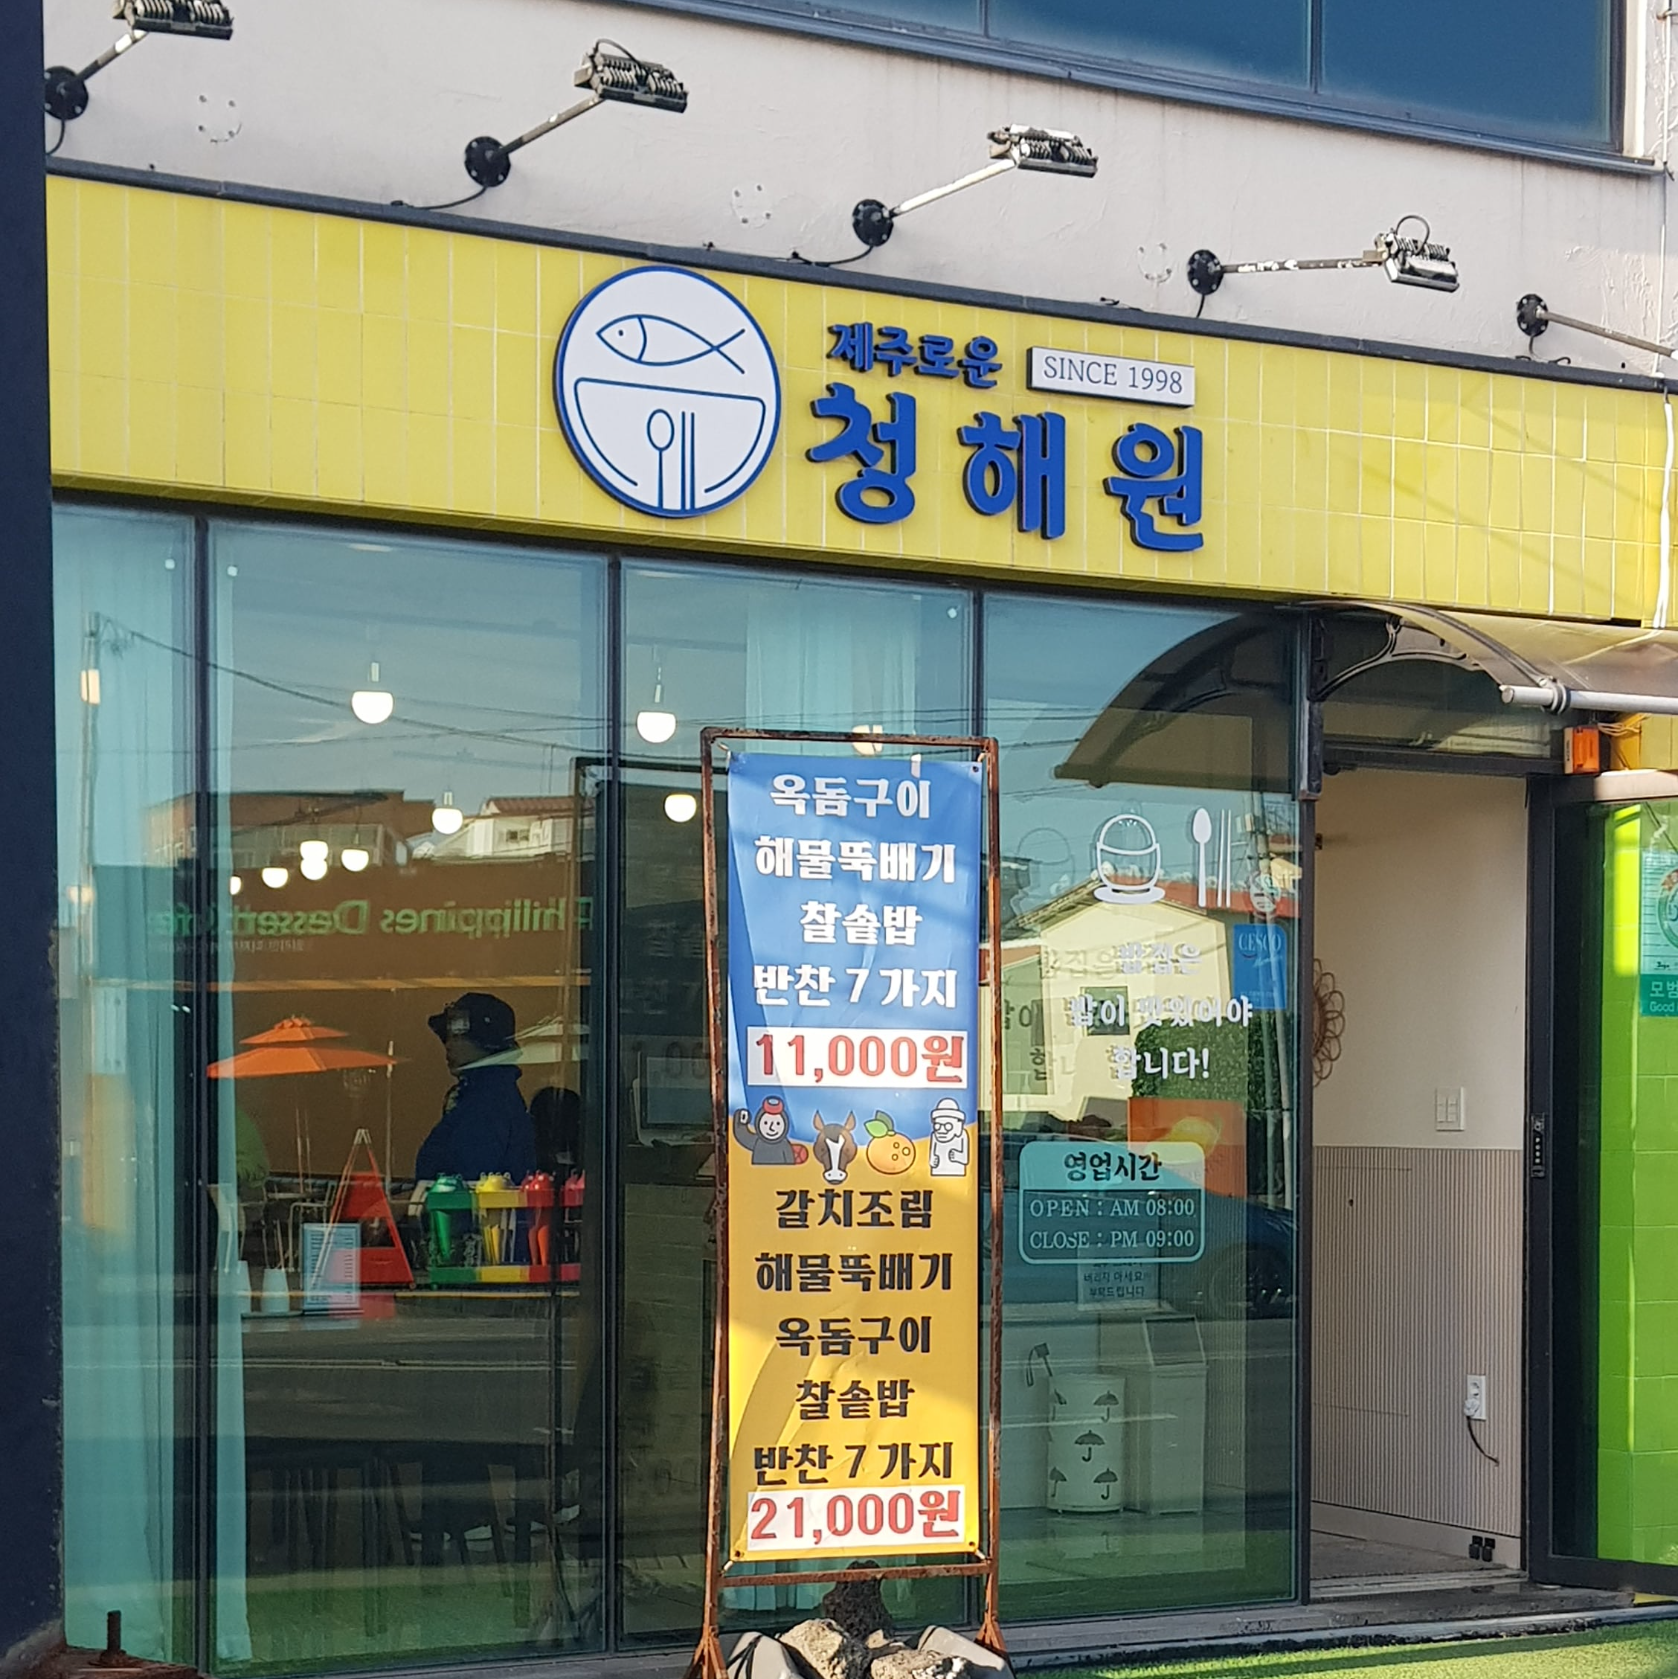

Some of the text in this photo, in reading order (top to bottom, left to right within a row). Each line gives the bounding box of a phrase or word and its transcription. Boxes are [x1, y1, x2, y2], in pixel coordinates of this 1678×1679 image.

[827, 322, 1003, 388] 제주로운
[1043, 355, 1183, 395] SINCE 1998
[770, 773, 931, 819] 옥돔구이
[754, 835, 957, 884] 해물뚝배기
[800, 901, 923, 946] 찰솥밥
[1238, 932, 1282, 952] CESCO
[1116, 941, 1203, 976] 밥집은
[753, 964, 837, 1008] 반찬
[1650, 1000, 1675, 1013] Good
[1070, 993, 1126, 1028] 밥이
[1137, 994, 1254, 1028] 맛있어야
[756, 1033, 965, 1084] 11,000원
[1112, 1045, 1210, 1080] 합니다!
[1064, 1151, 1163, 1183] 영업시간
[775, 1188, 935, 1230] 갈치조림
[1029, 1199, 1090, 1218] OPEN
[1109, 1199, 1140, 1218] AM
[1146, 1198, 1195, 1217] 08:00
[1029, 1231, 1090, 1250] CLOSE
[1109, 1230, 1138, 1249] PM
[1146, 1229, 1195, 1249] 09:00
[754, 1252, 953, 1292] 해물뚝배기
[775, 1315, 932, 1356] 옥돔구이
[795, 1379, 915, 1420] 찰솥밥
[753, 1443, 834, 1486] 반찬
[750, 1489, 962, 1546] 21,000원
